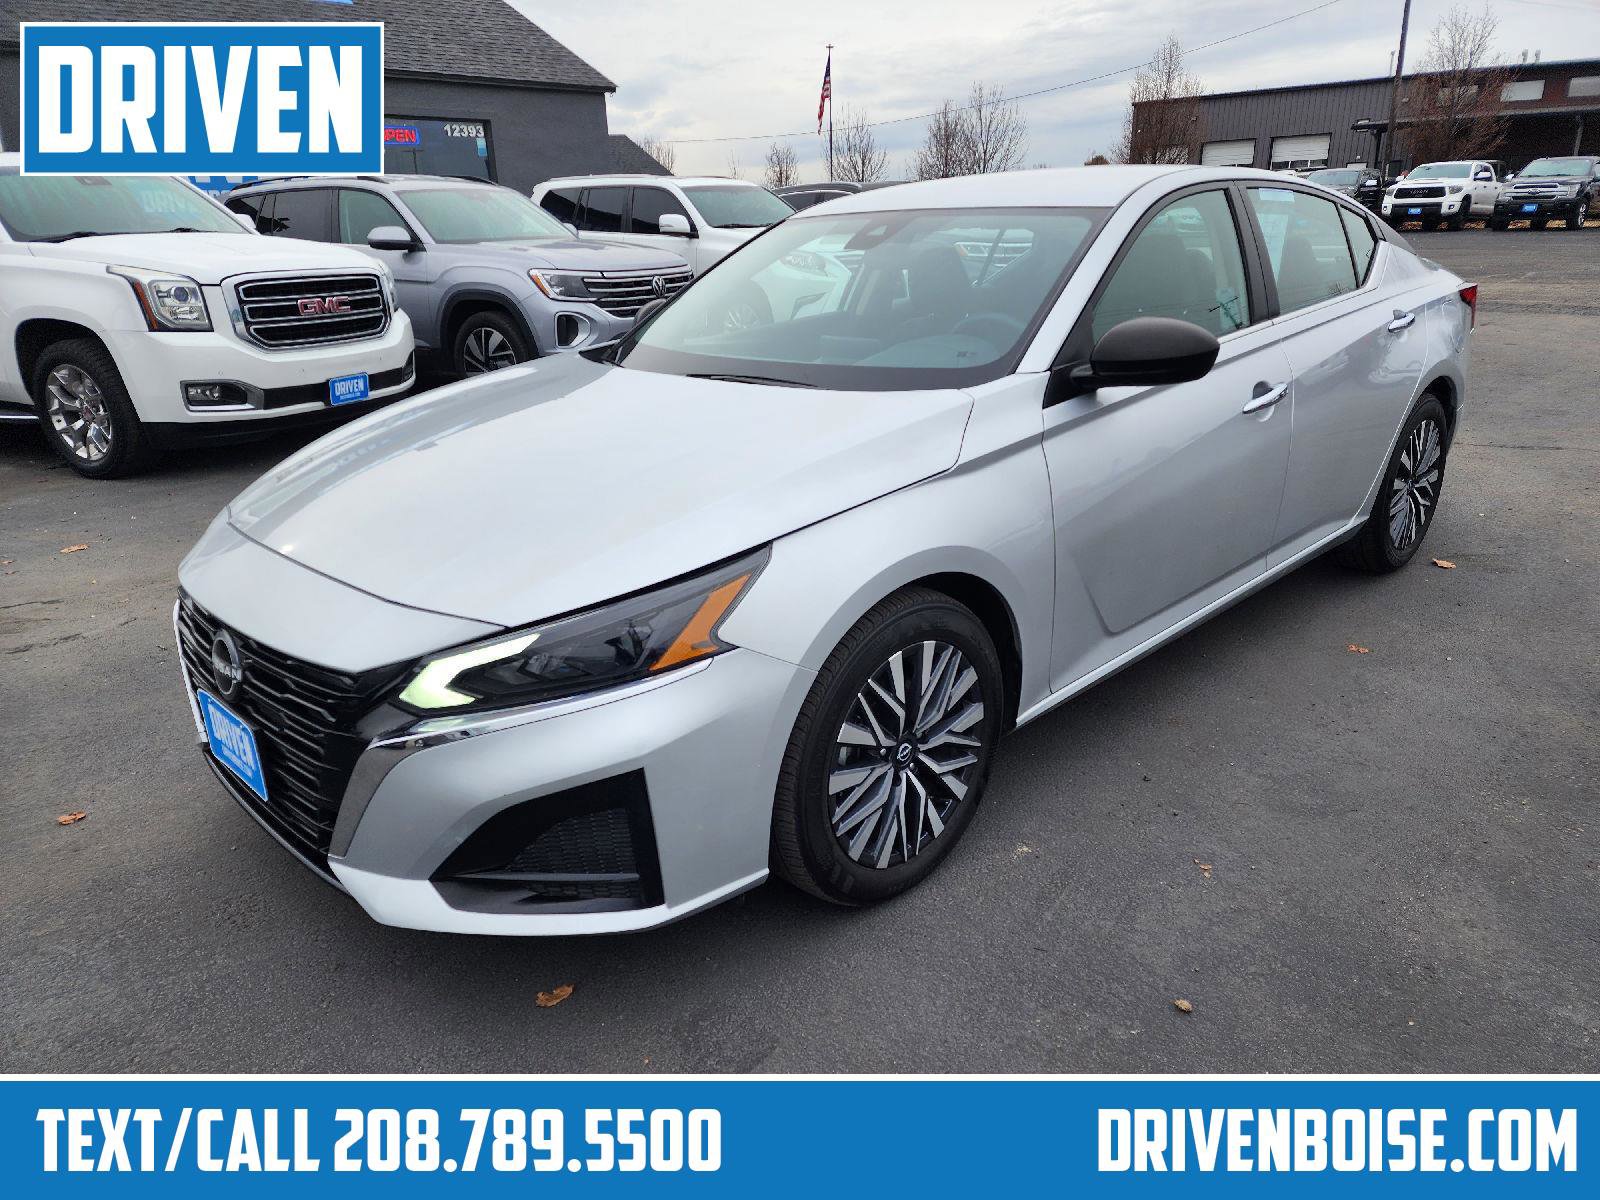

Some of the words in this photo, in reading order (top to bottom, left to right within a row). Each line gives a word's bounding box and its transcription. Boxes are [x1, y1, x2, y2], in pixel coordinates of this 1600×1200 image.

[384, 129, 416, 142] PEN
[444, 123, 484, 137] 12393
[297, 295, 351, 315] GMC
[334, 378, 364, 396] DRIVEN
[207, 703, 256, 771] DRIVEN
